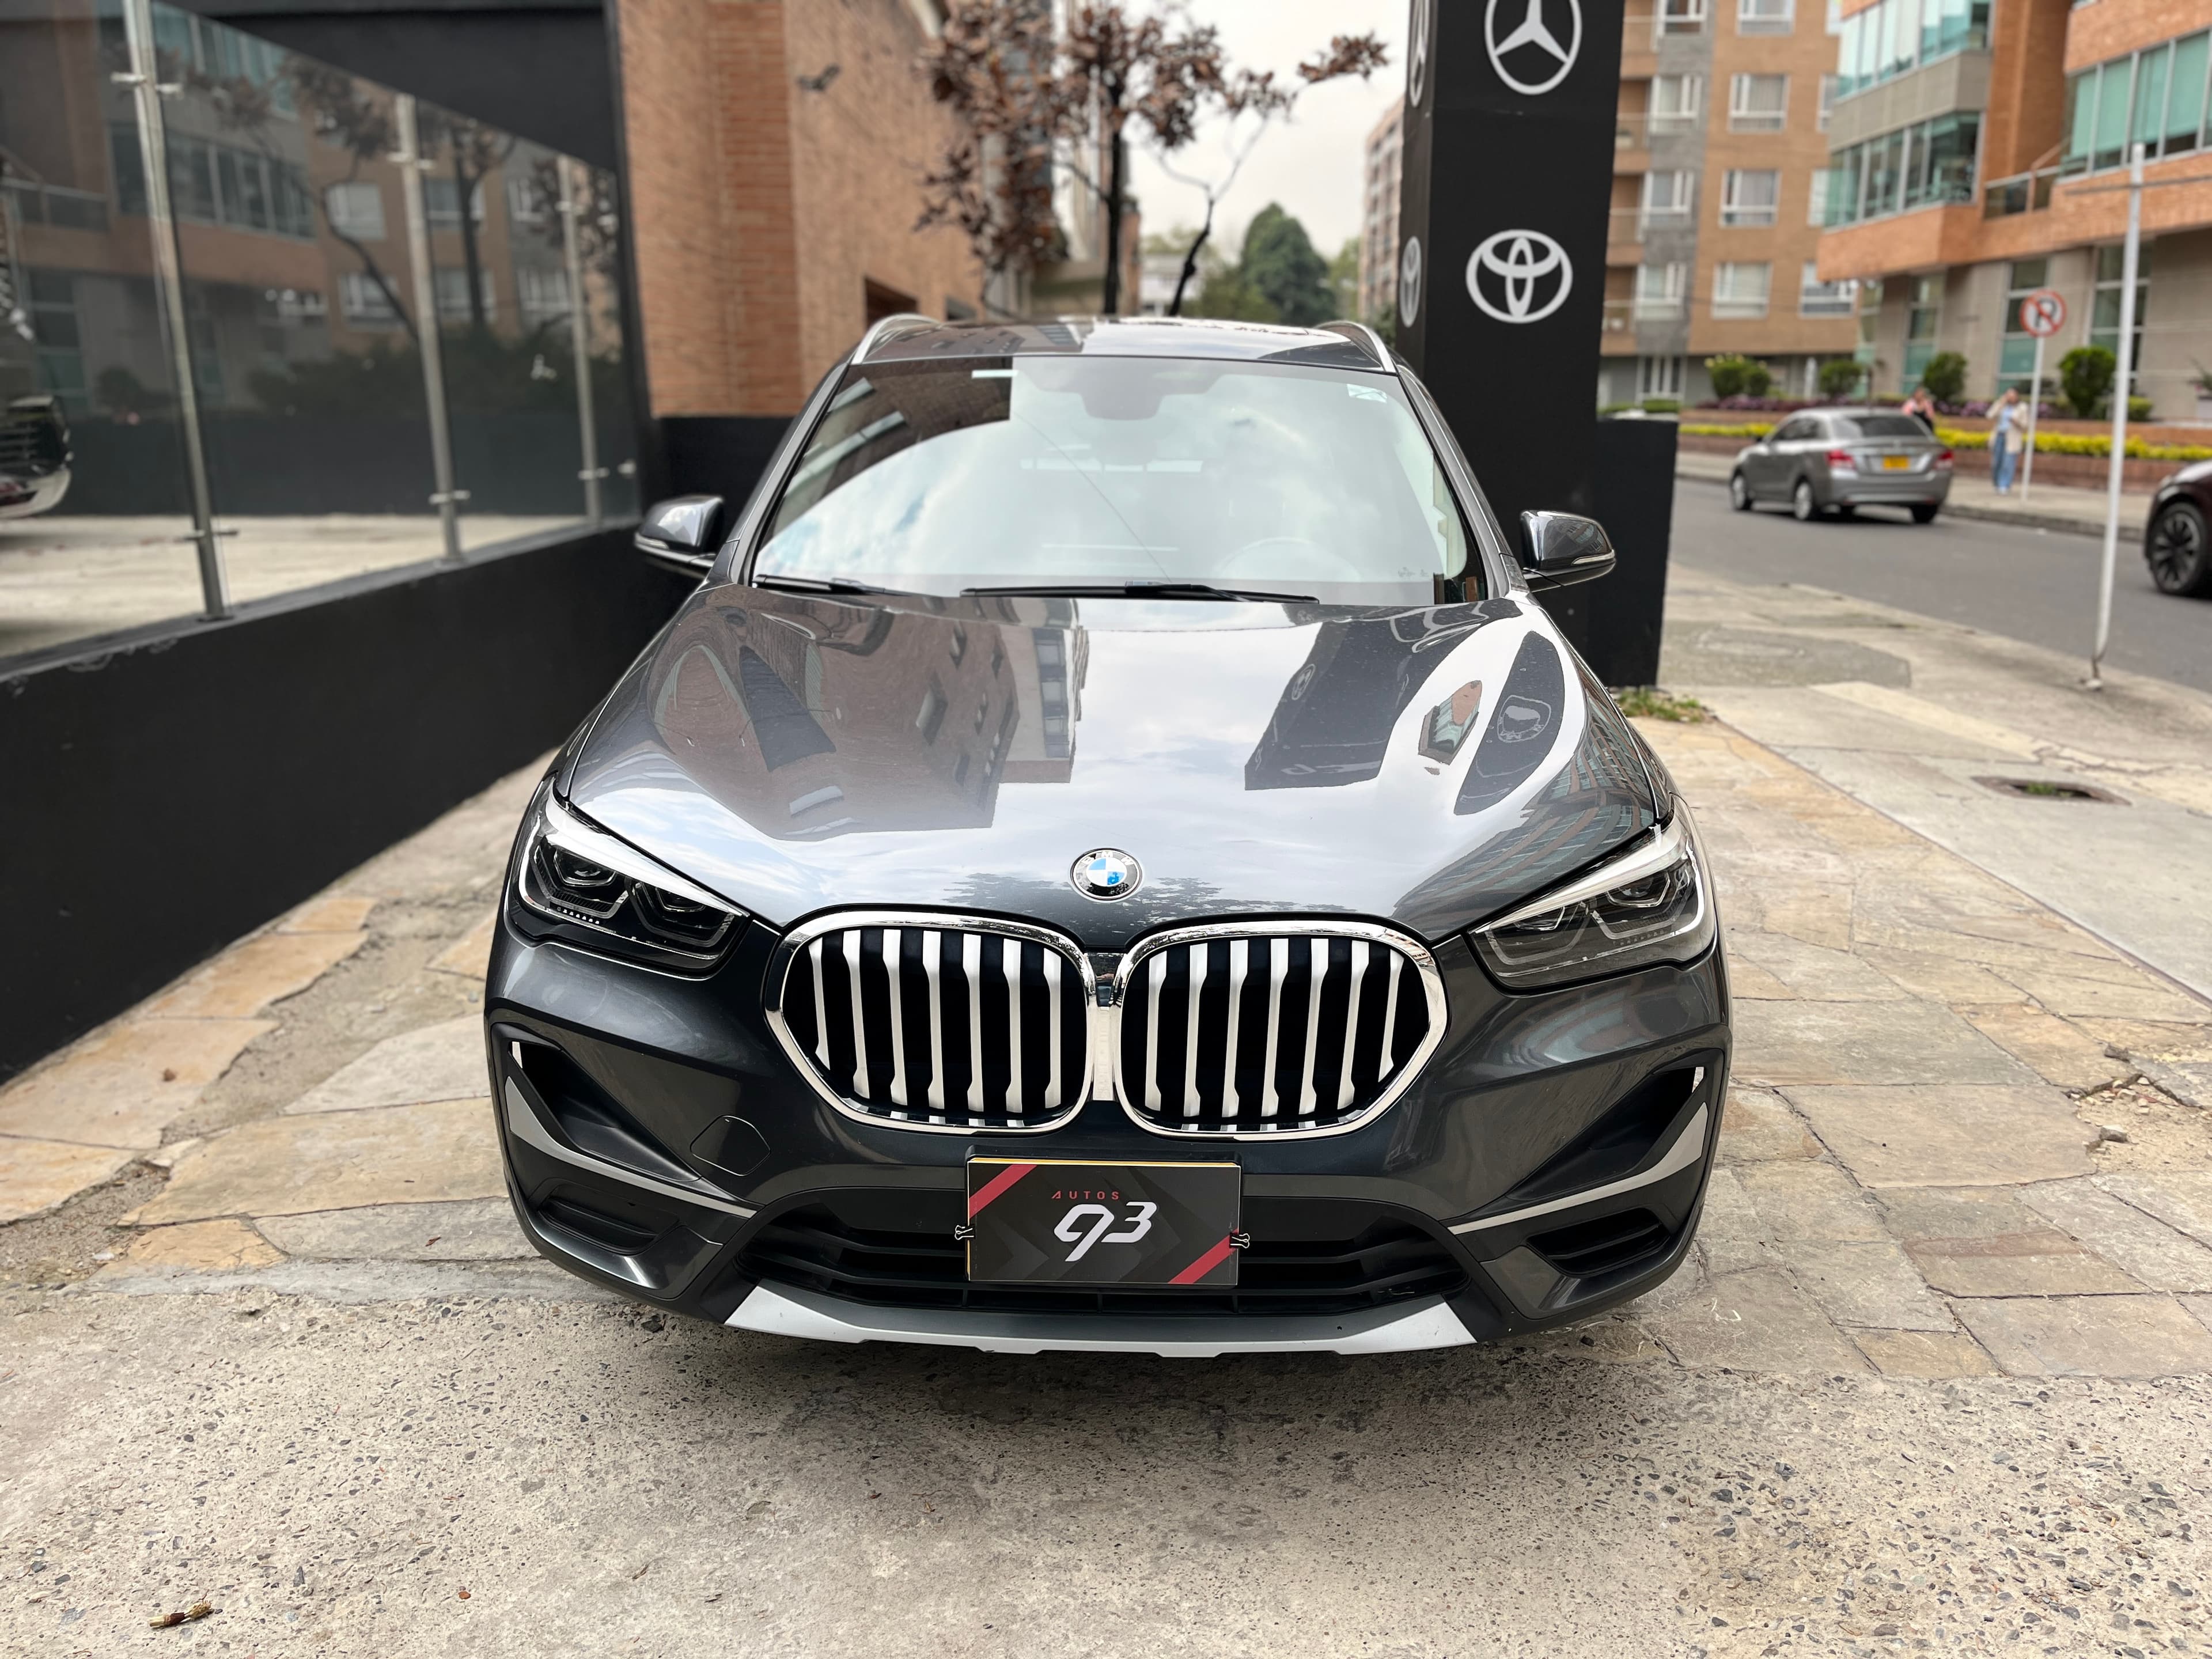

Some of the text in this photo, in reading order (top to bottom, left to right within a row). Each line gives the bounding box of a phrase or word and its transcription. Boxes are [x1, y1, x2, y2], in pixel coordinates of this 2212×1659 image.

[1080, 851, 1134, 865] BMW
[1051, 1190, 1120, 1200] AUTOS
[1054, 1201, 1157, 1262] 93
